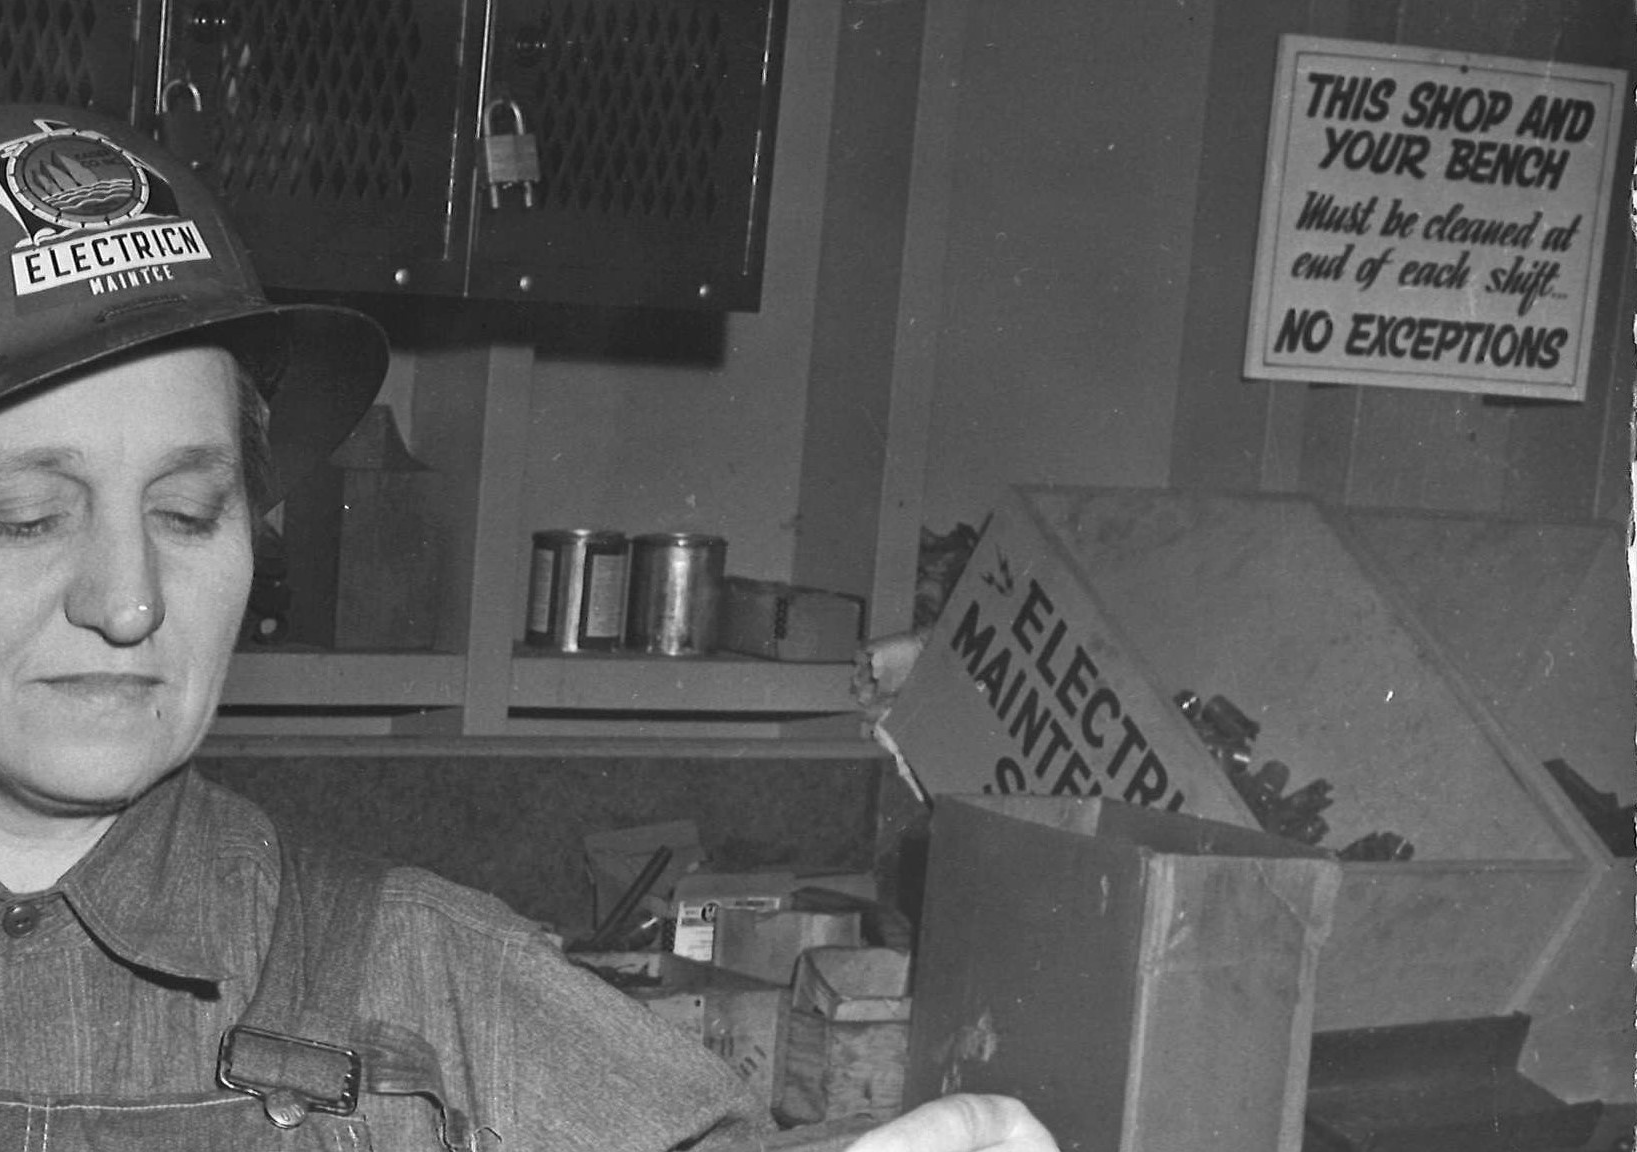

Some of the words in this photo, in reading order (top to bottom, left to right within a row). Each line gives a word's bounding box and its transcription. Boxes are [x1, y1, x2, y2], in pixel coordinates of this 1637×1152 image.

[1307, 72, 1397, 122] THIS
[1402, 81, 1512, 133] SHOP
[1516, 95, 1595, 143] AND
[1318, 127, 1431, 179] YOUR
[1445, 138, 1570, 190] BENCH
[1296, 191, 1379, 235] Must
[1380, 198, 1422, 240] be
[1422, 203, 1543, 249] cleaned
[1542, 214, 1583, 251] at
[25, 226, 200, 284] ELECTRICN
[1292, 244, 1355, 280] end
[1356, 248, 1396, 292] of
[1398, 250, 1470, 289] each
[1274, 307, 1334, 353] NO
[1345, 313, 1568, 369] EXCEPTIONS
[950, 600, 1102, 797] MAINTE
